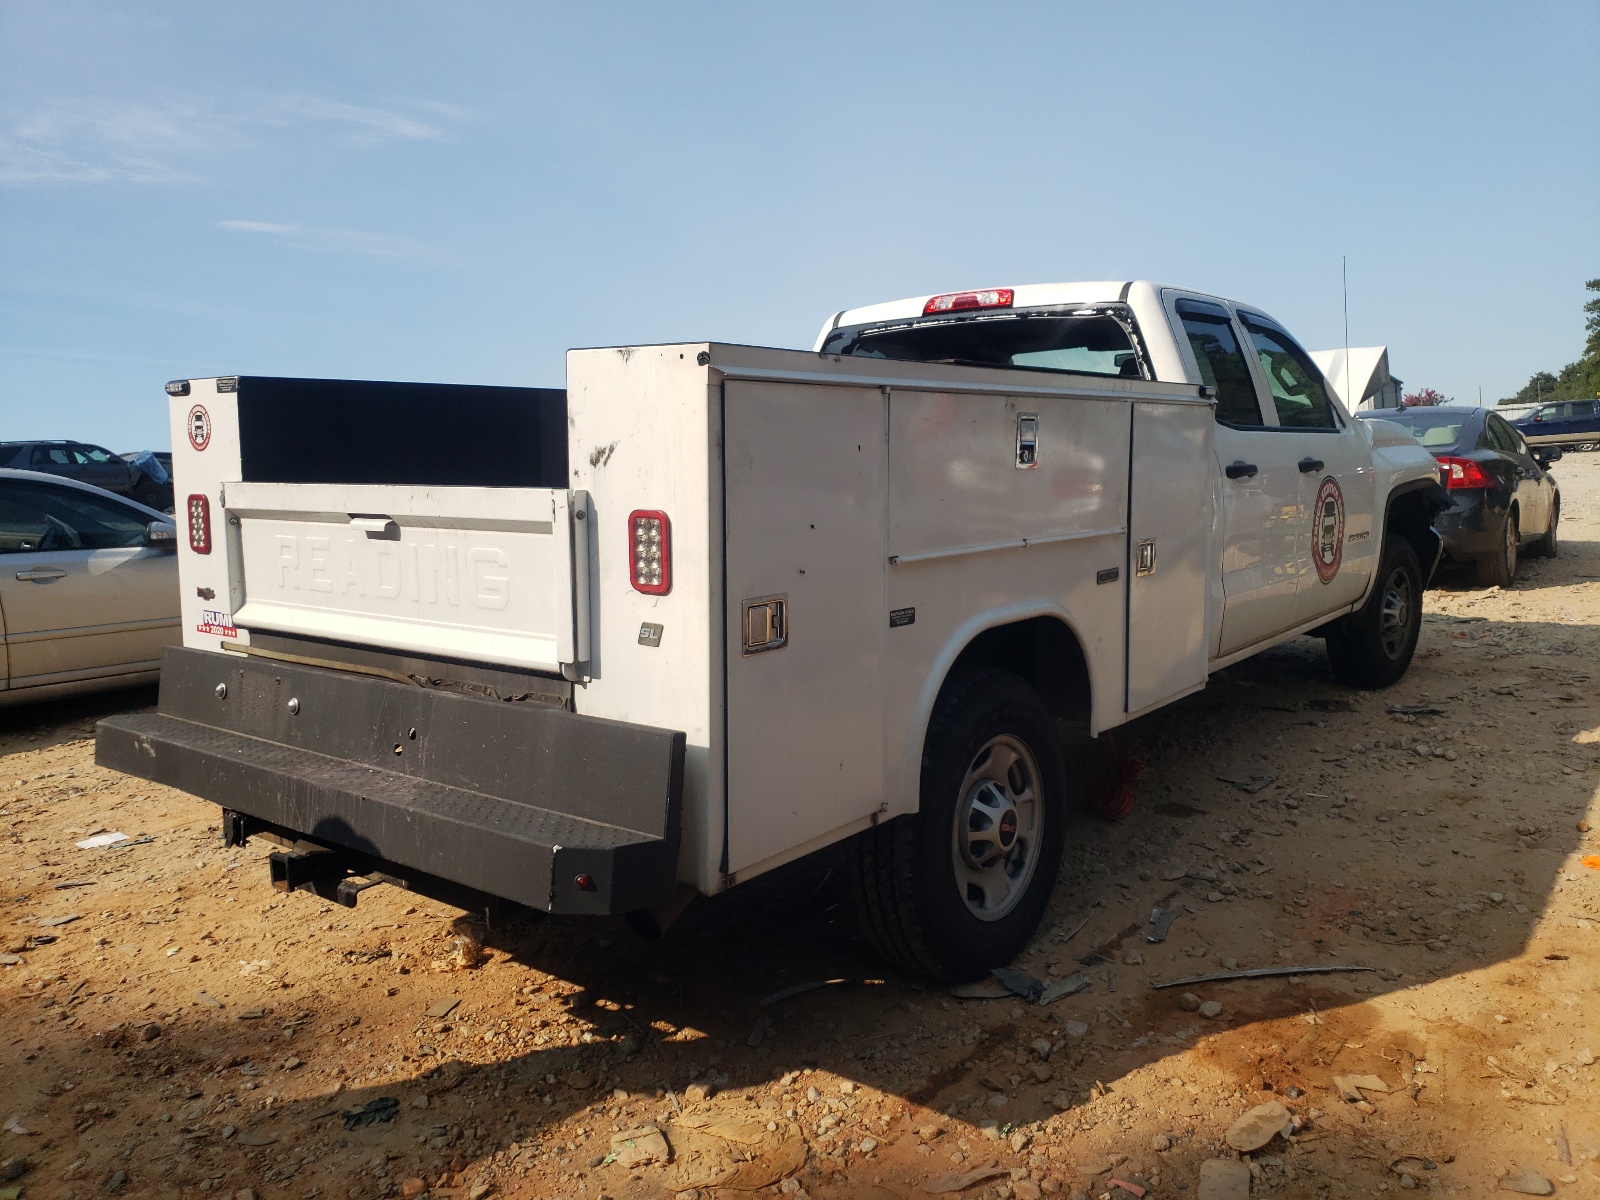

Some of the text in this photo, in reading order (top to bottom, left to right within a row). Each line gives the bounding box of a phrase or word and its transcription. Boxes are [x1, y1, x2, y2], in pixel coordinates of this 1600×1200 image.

[274, 535, 509, 611] READING
[210, 625, 224, 636] 2020
[640, 627, 660, 639] SL
